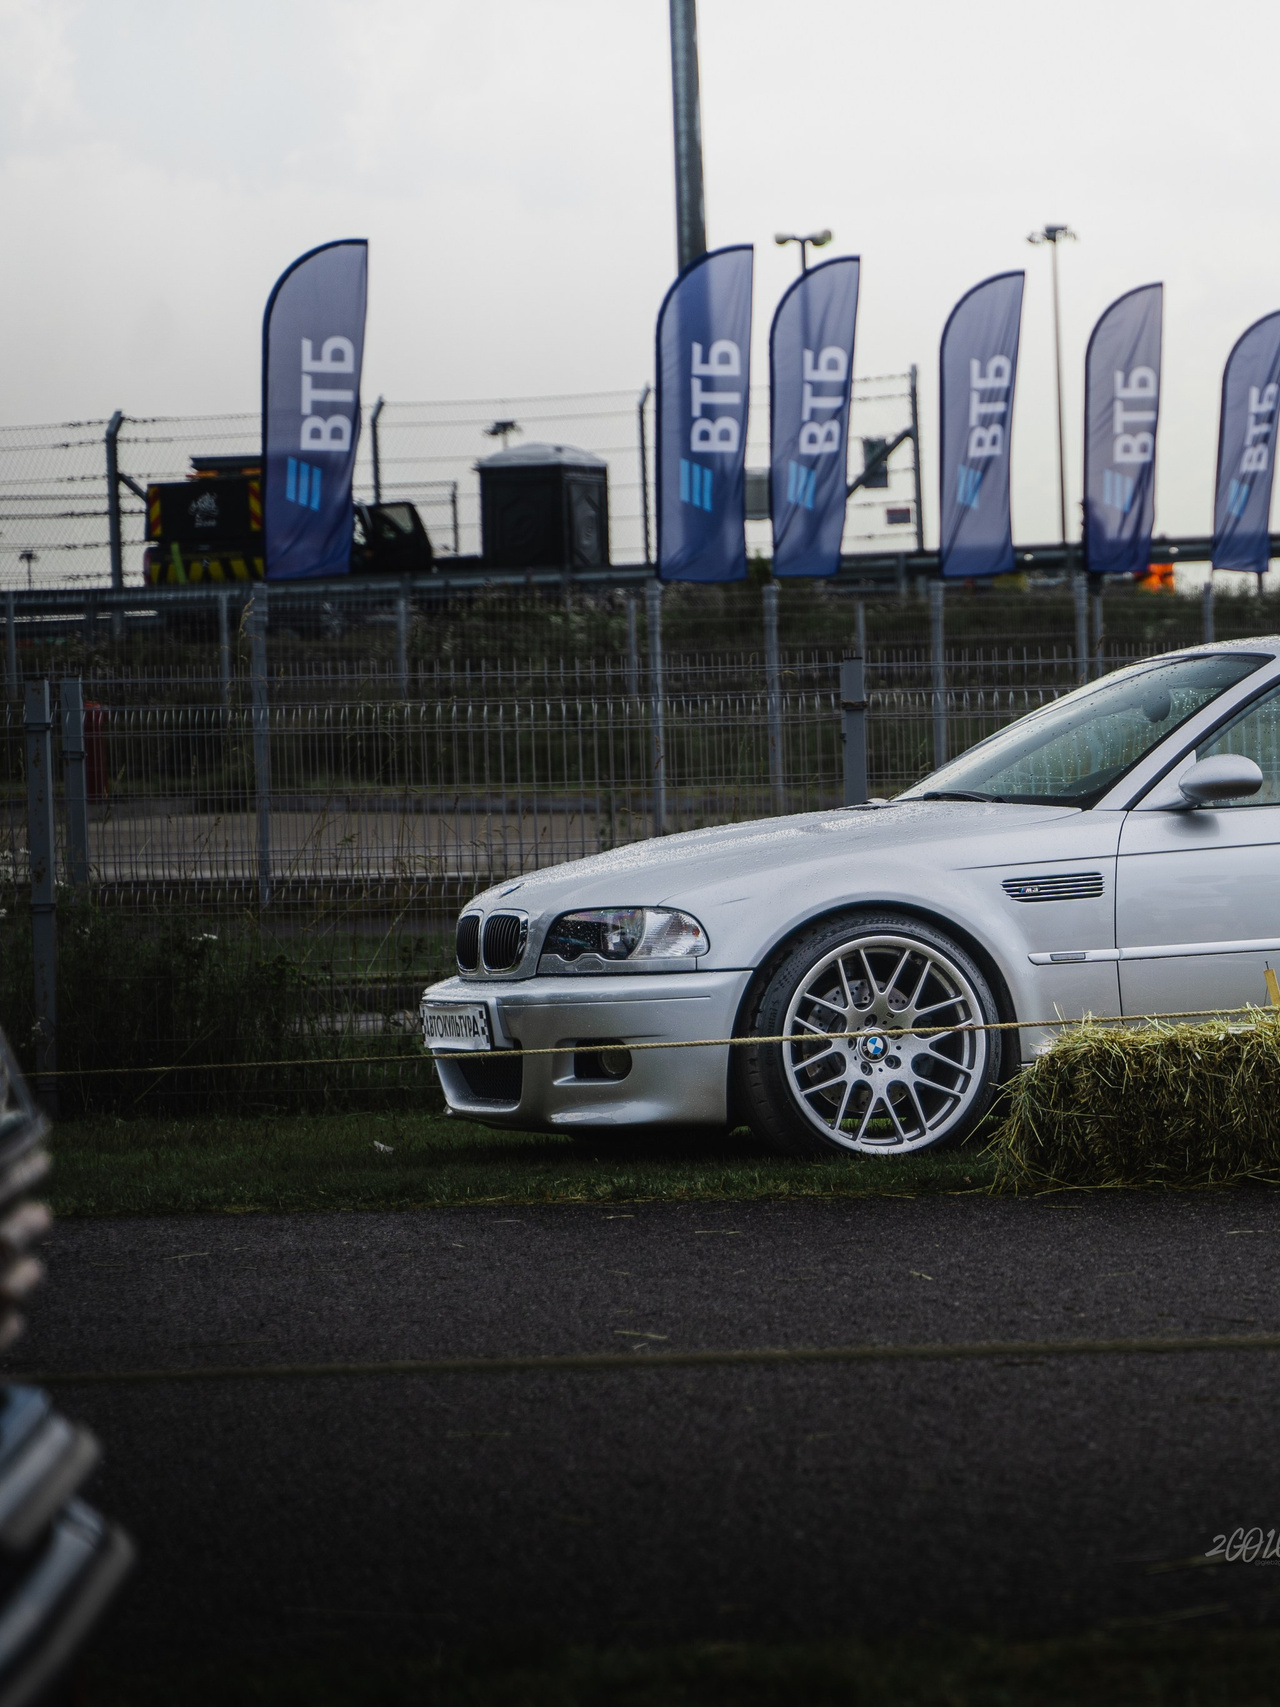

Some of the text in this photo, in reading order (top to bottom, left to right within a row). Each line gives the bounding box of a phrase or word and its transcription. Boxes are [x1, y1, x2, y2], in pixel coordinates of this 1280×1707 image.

[301, 334, 355, 452] ВТБ
[690, 338, 741, 453] ВТБ
[799, 344, 849, 455] ВТБ
[968, 353, 1012, 458] ВТБ
[1112, 365, 1158, 463] ВТБ
[1241, 382, 1278, 473] ВТБ
[426, 1015, 480, 1038] АВТОКУЛЬТУРА
